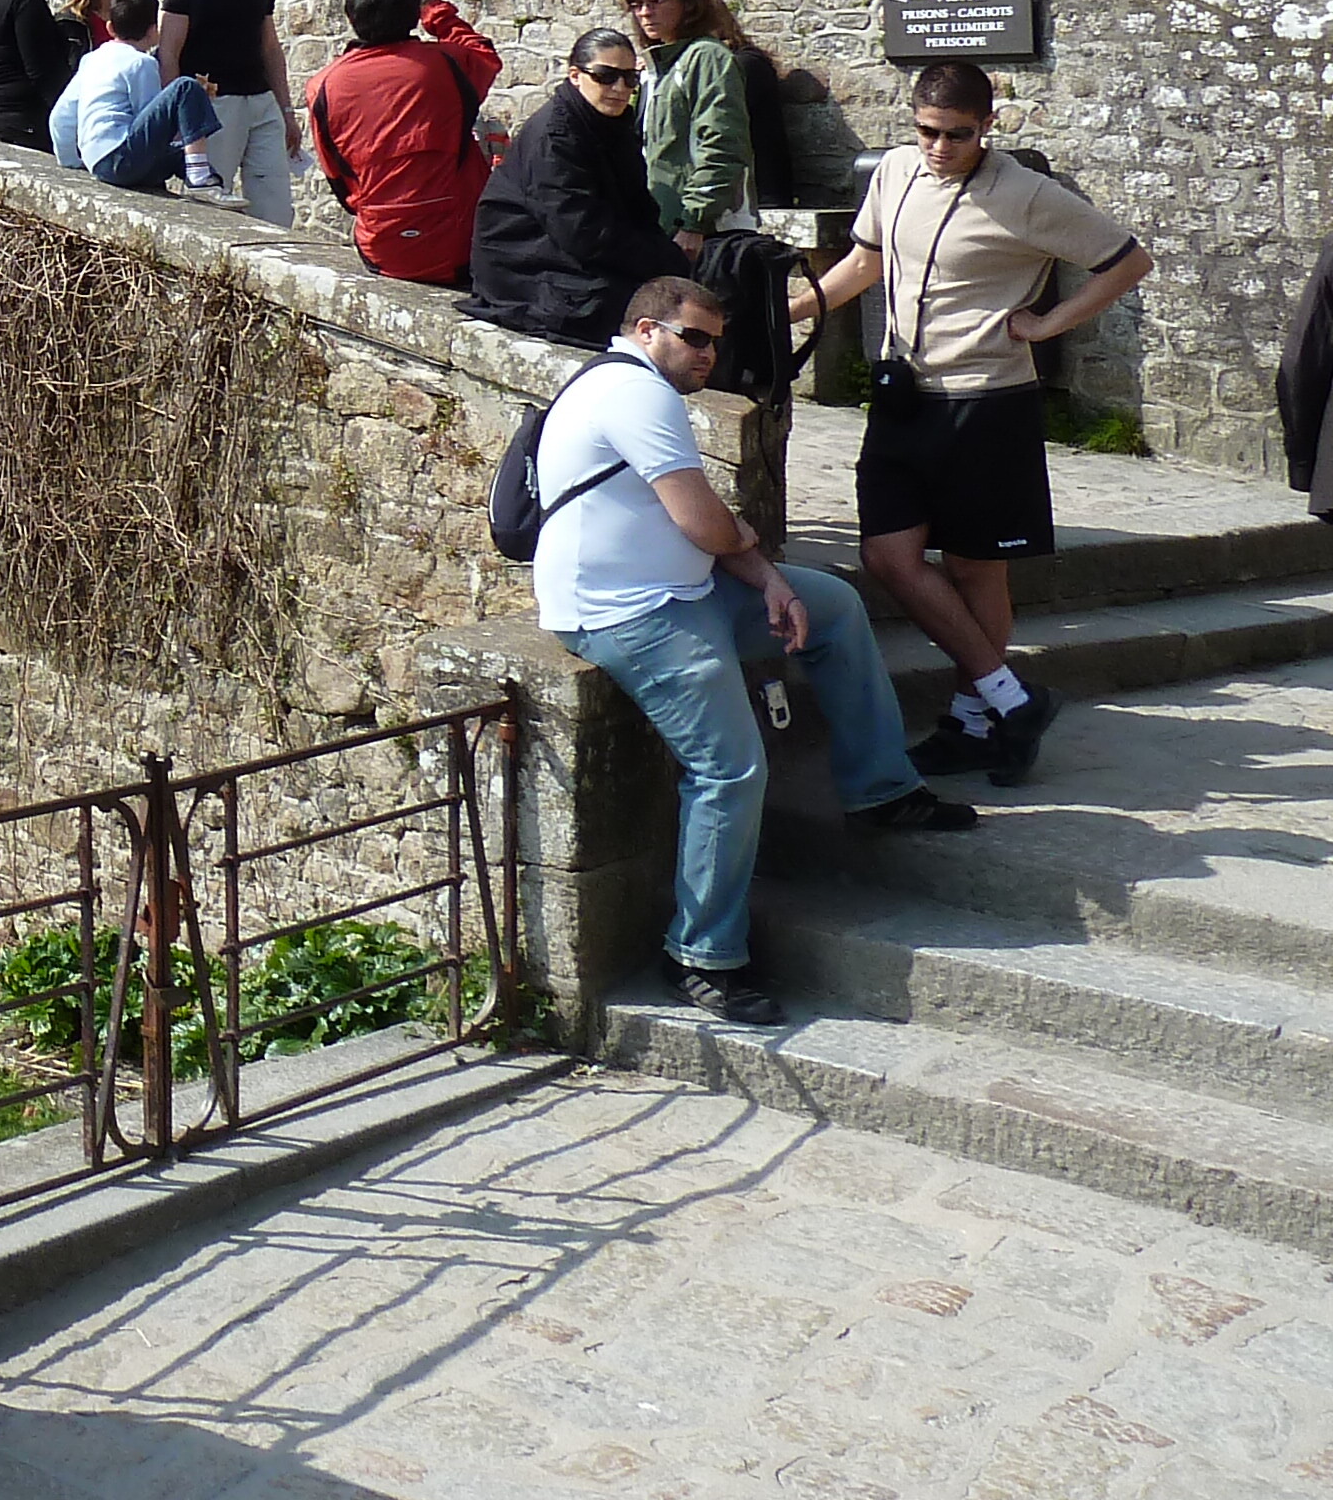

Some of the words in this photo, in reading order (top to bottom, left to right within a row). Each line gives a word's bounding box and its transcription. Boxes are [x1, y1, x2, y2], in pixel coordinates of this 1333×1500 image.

[901, 8, 949, 20] PRISONS
[957, 6, 1014, 18] CACHOTS
[906, 24, 931, 34] SON
[933, 23, 949, 33] ET
[951, 21, 1005, 32] LUMIERE
[925, 36, 987, 48] PERISCOPE
